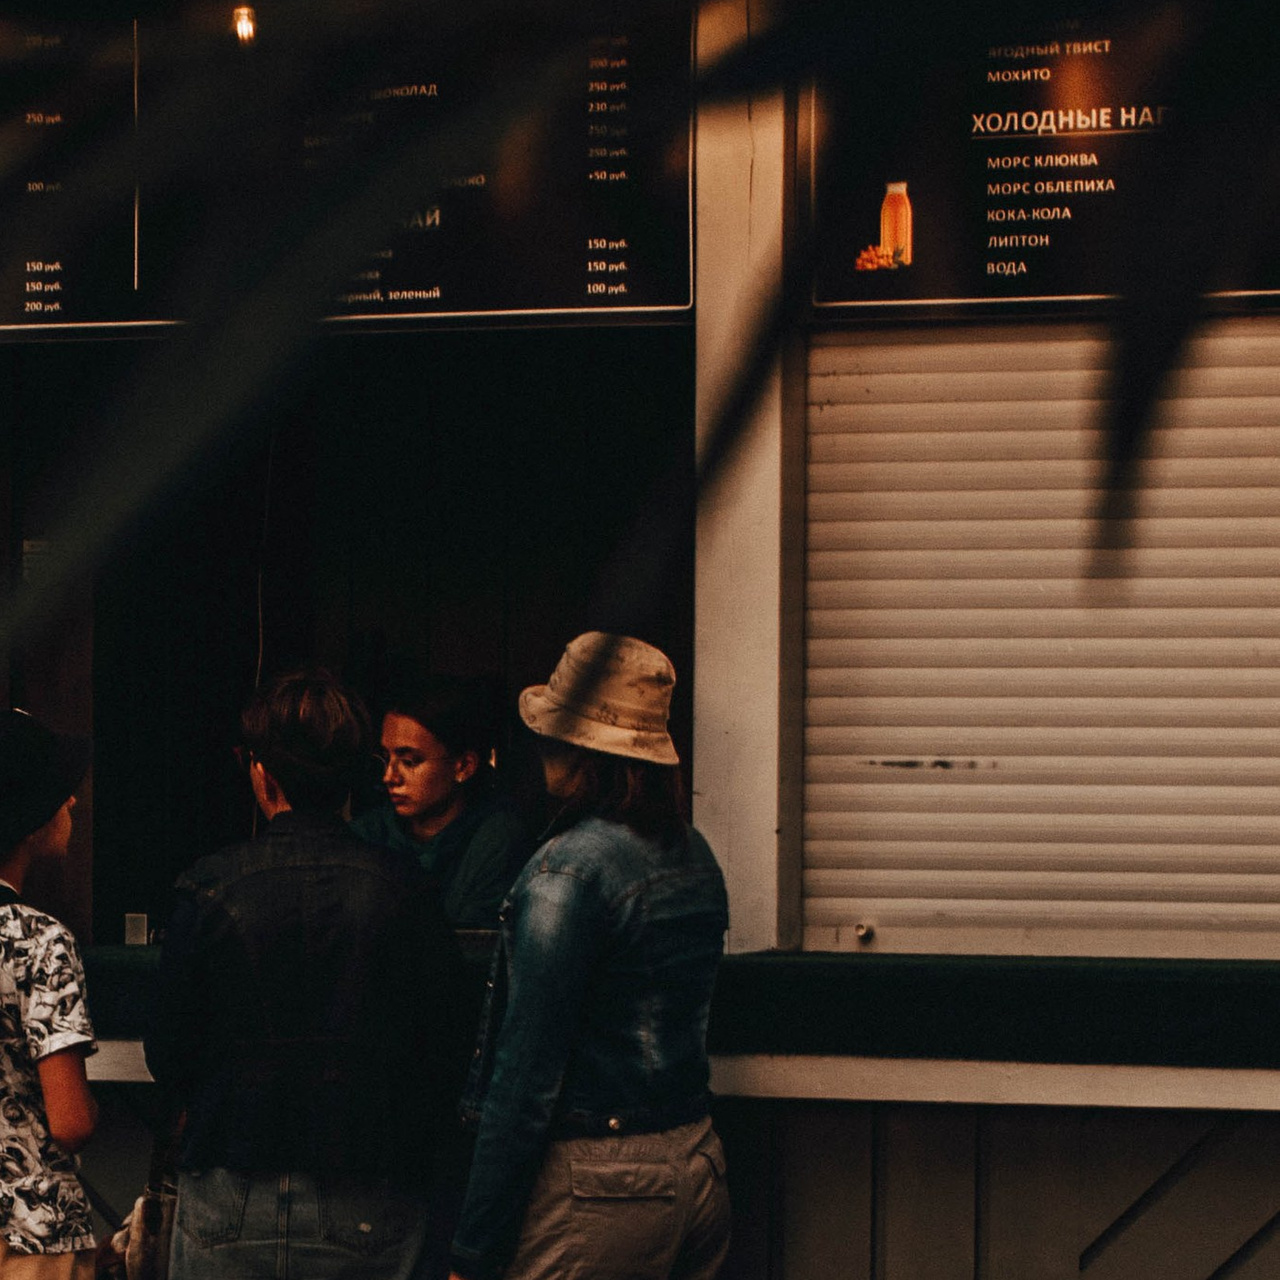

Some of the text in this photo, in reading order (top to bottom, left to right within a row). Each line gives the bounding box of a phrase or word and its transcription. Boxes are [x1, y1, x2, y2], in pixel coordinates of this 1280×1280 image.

[1064, 38, 1112, 56] ТВИСТ
[987, 67, 1051, 83] МОХИТО
[971, 106, 1113, 136] ХОЛОДНЫЕ
[987, 152, 1099, 169] МОРС КЛЮКВА
[987, 179, 1116, 196] МОРС ОБЛЕПИХА
[987, 206, 1072, 222] КОКА-КОЛА
[587, 238, 607, 250] 150
[987, 233, 1050, 249] ЛИПТОН
[26, 261, 43, 272] 150
[587, 261, 607, 272] 150
[987, 260, 1028, 276] ВОДА
[25, 281, 43, 292] 150
[388, 284, 442, 300] зеленый
[586, 282, 606, 294] 100
[24, 301, 43, 312] 200
